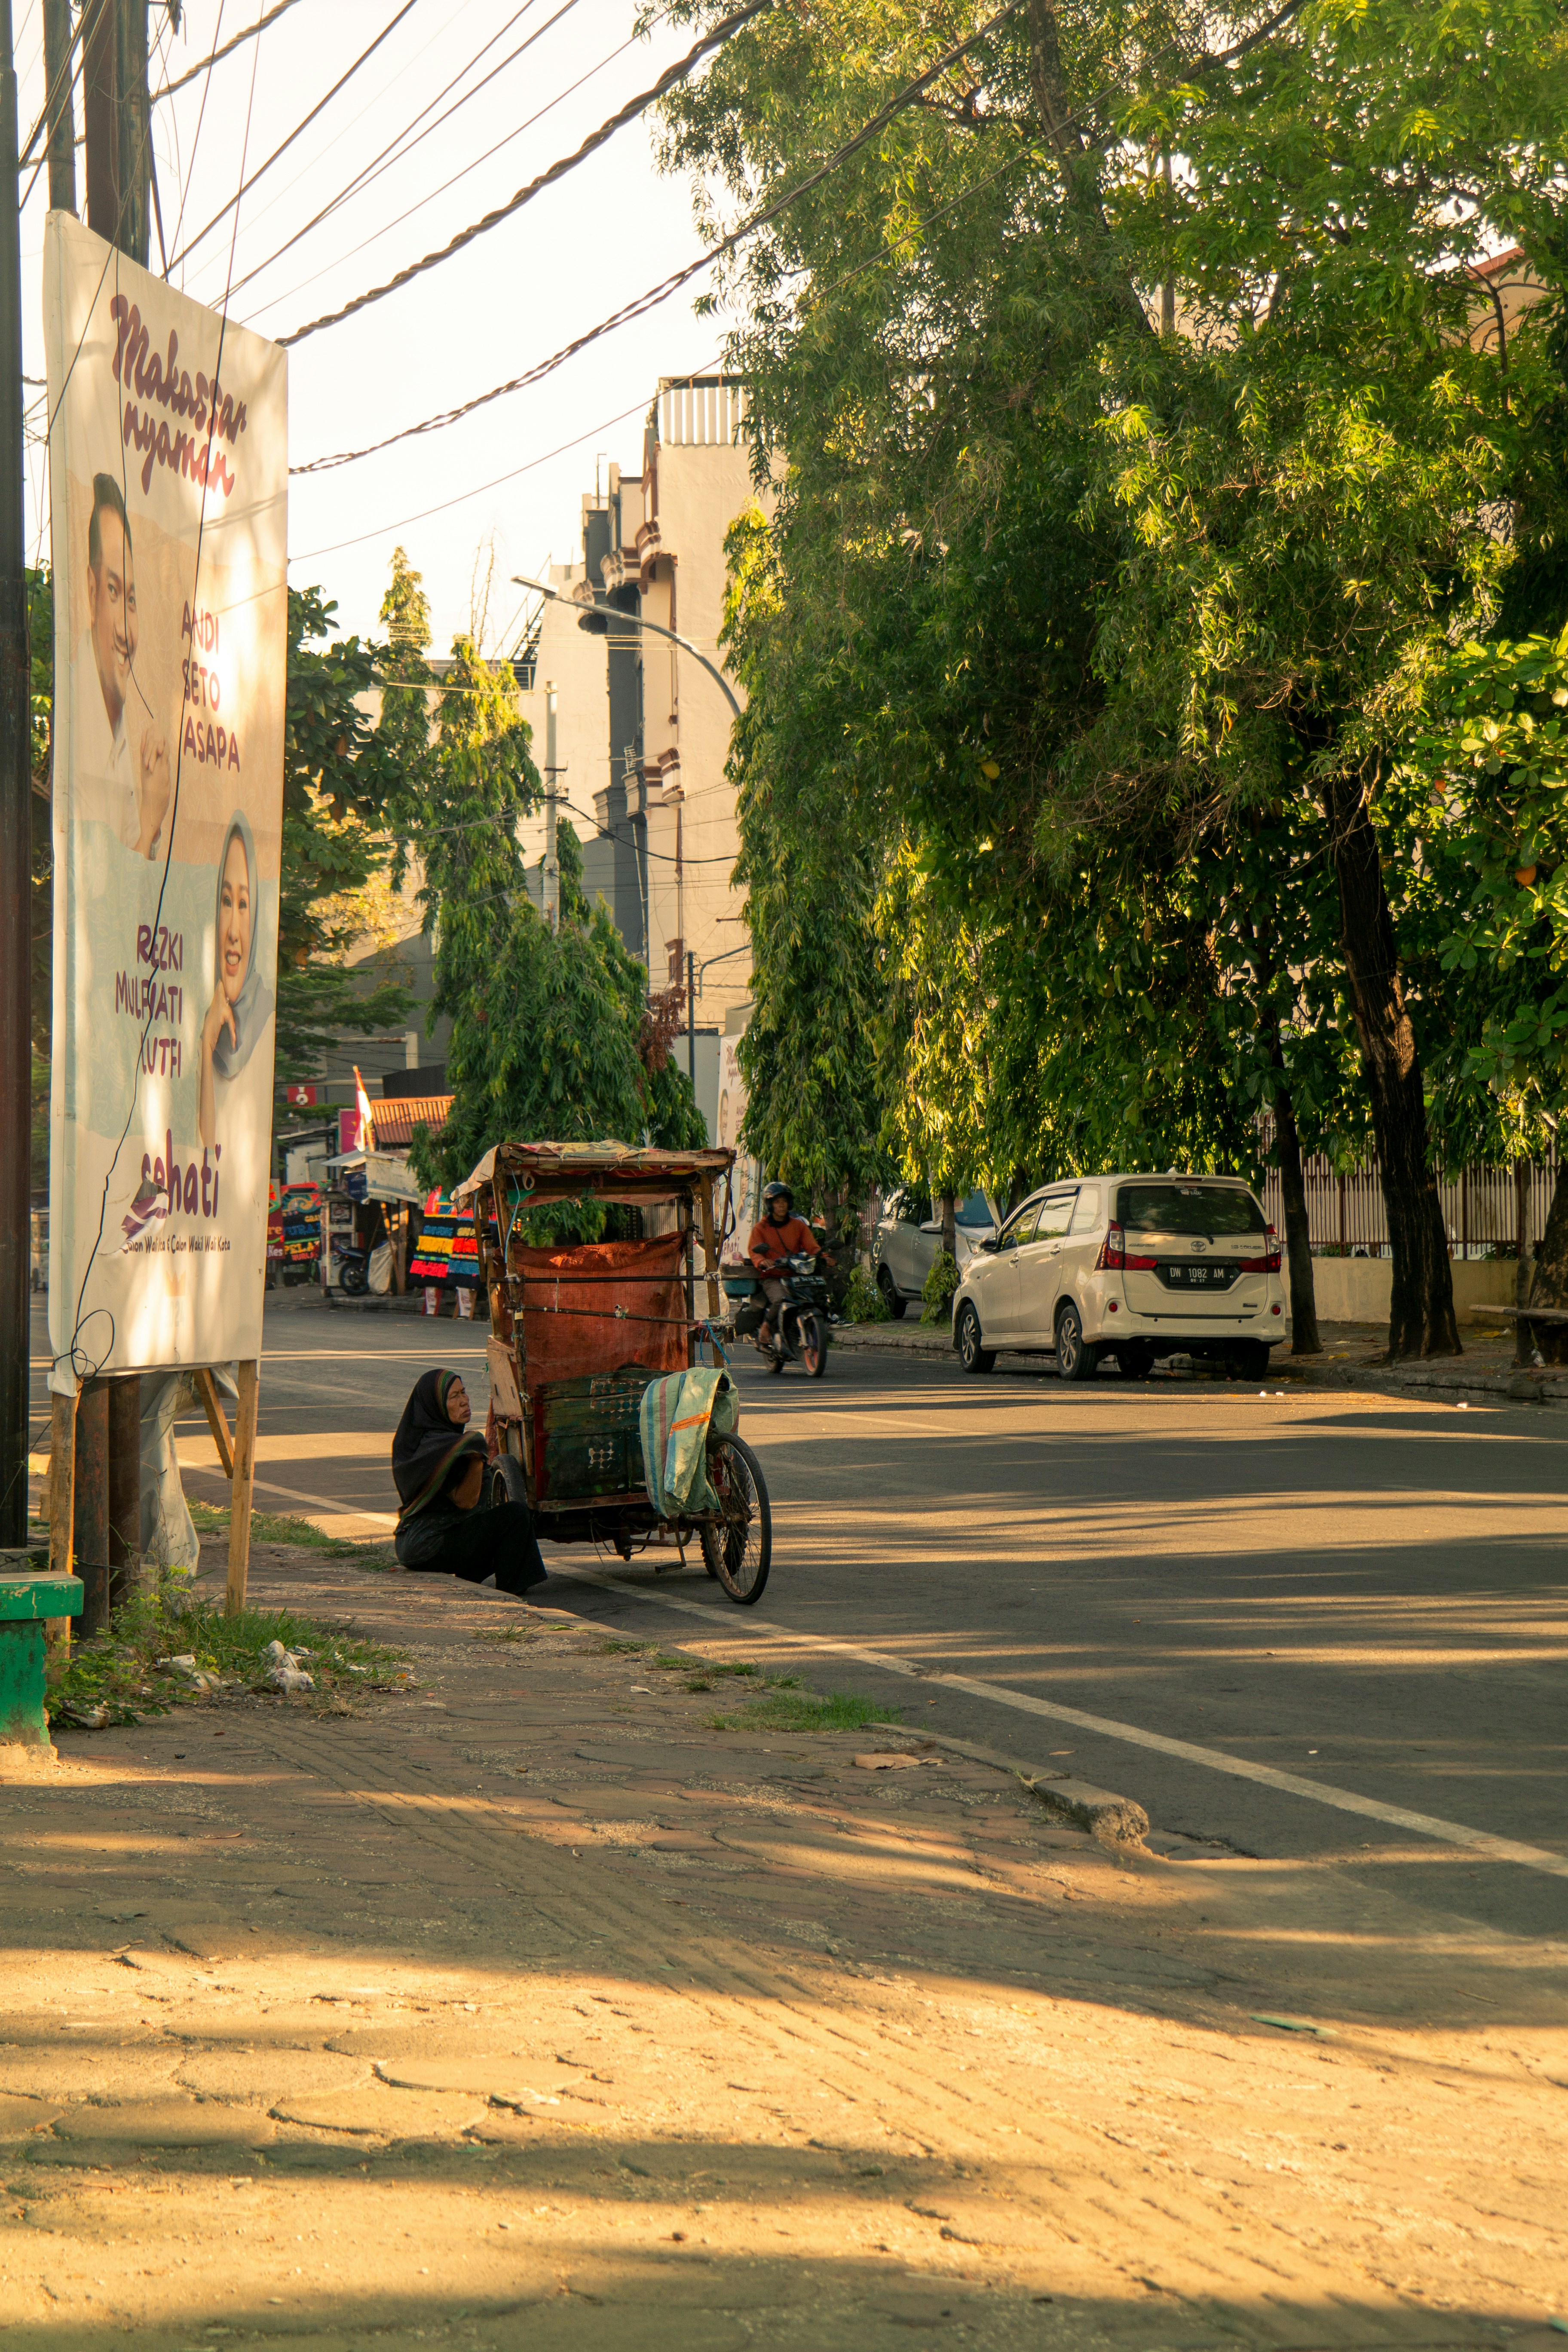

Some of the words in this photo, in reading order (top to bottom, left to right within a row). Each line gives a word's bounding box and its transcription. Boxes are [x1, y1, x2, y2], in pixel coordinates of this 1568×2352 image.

[110, 294, 247, 445] Makassar
[124, 401, 235, 497] nyaman
[181, 600, 219, 655] ANDI
[182, 658, 220, 712] SETO
[184, 716, 240, 773] ASAPA
[137, 925, 183, 971] REZKI
[141, 1032, 181, 1079] LUTFI
[171, 1234, 187, 1254] Calon
[189, 1236, 203, 1253] Wakil
[205, 1236, 217, 1253] Wali
[217, 1236, 230, 1253] Kota
[1170, 1268, 1181, 1277] DW
[1188, 1268, 1207, 1278] 1082
[1213, 1268, 1224, 1278] AM
